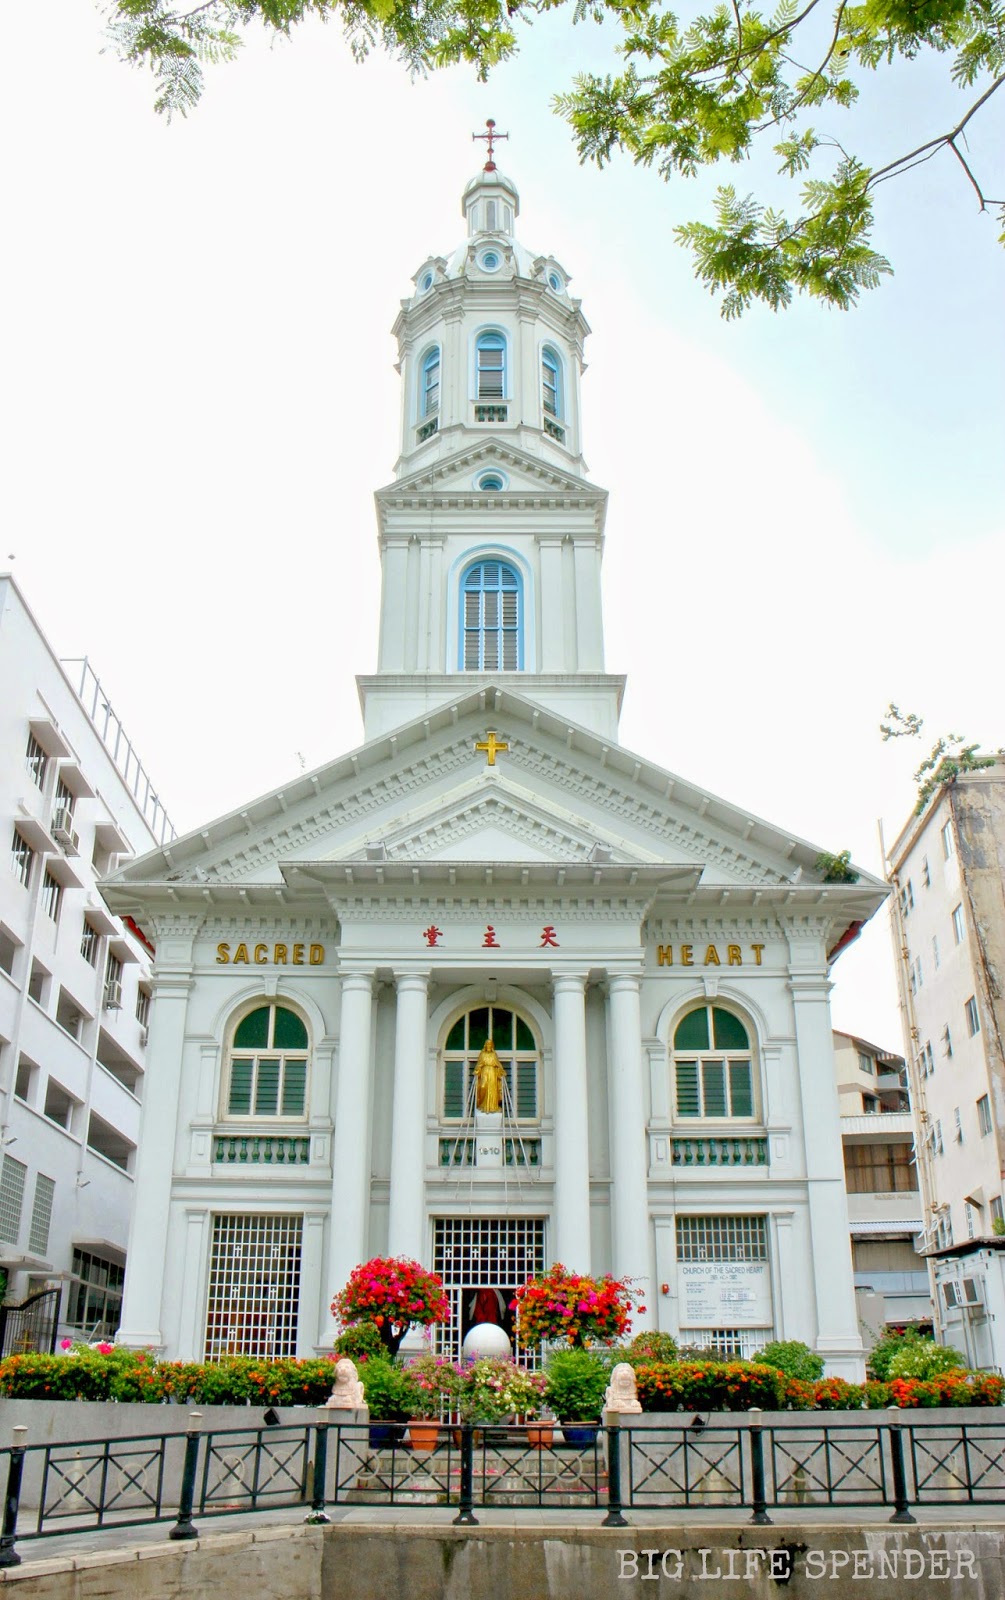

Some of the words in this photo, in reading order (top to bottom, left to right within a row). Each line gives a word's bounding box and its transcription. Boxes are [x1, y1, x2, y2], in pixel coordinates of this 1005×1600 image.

[216, 943, 325, 966] SACRED
[656, 944, 765, 967] HEART
[682, 1267, 704, 1275] CHURCH
[724, 1266, 745, 1274] SACRED
[746, 1266, 763, 1274] HEART
